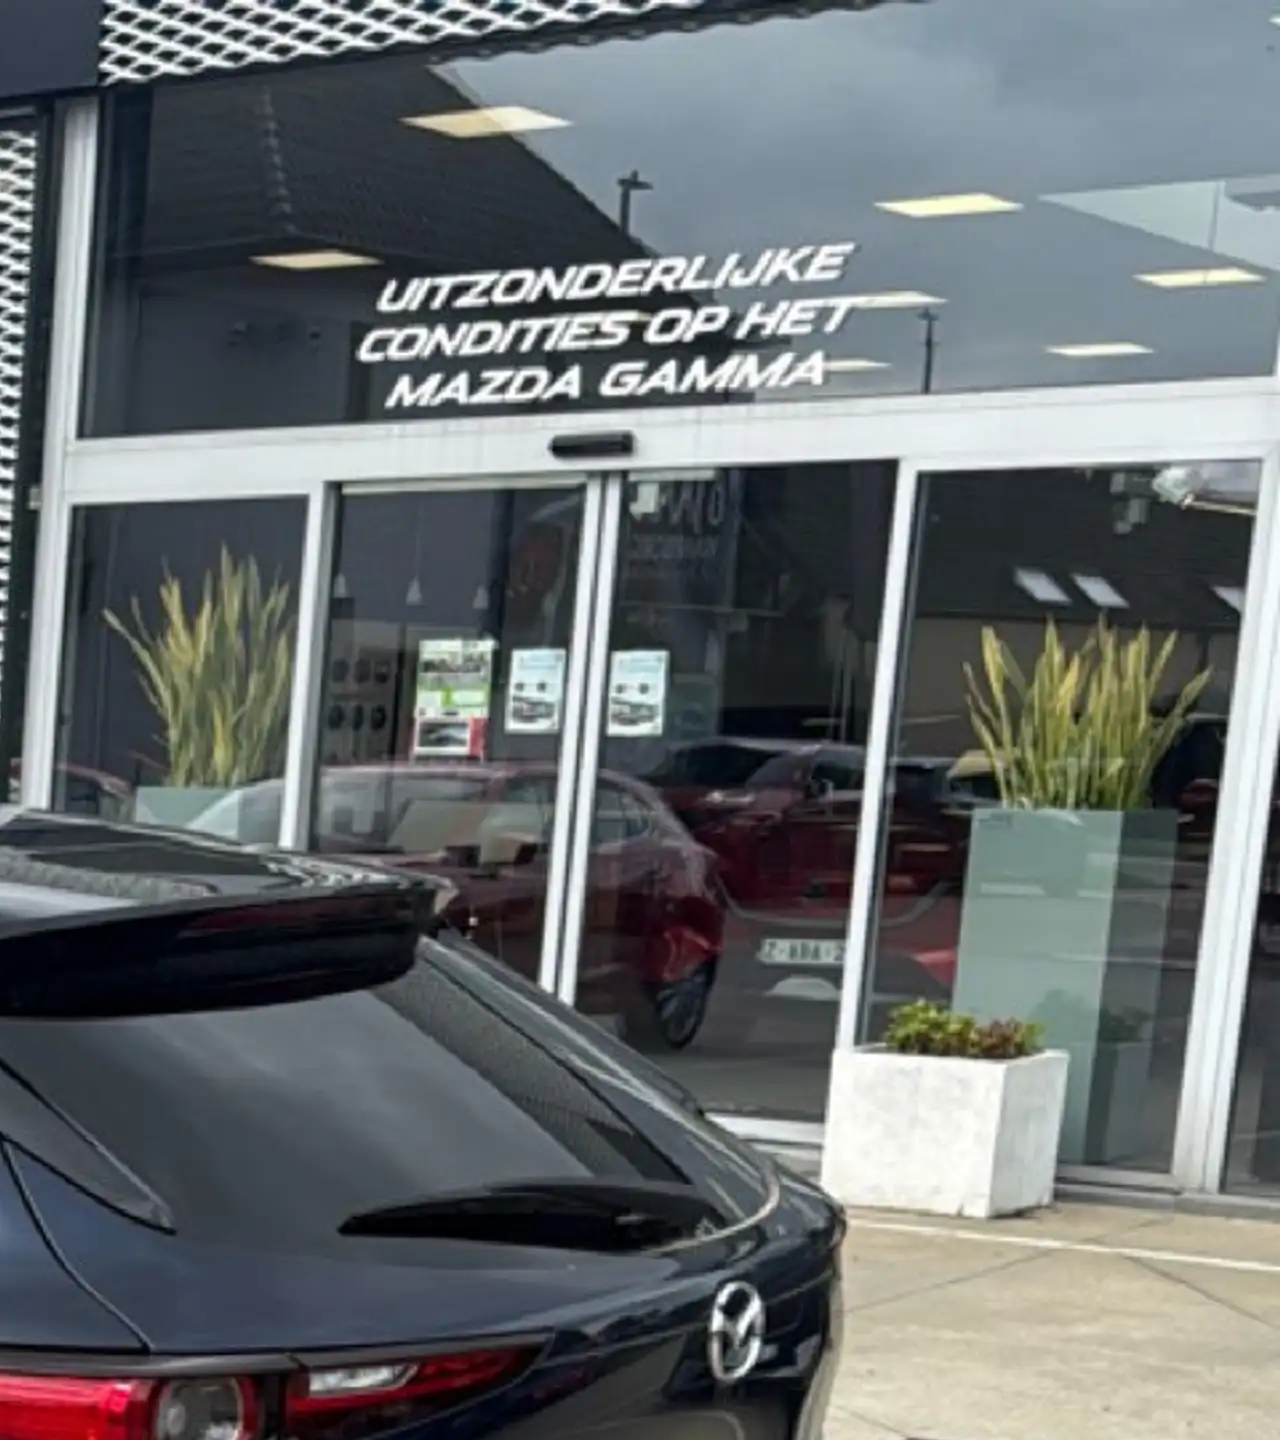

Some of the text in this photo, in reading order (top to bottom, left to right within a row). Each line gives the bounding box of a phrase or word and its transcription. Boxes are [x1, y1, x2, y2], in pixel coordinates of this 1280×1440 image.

[375, 242, 856, 313] UITZONDERLIJKE
[355, 298, 855, 363] CONDITIES OP HET
[383, 350, 827, 409] MAZDA GAMMA
